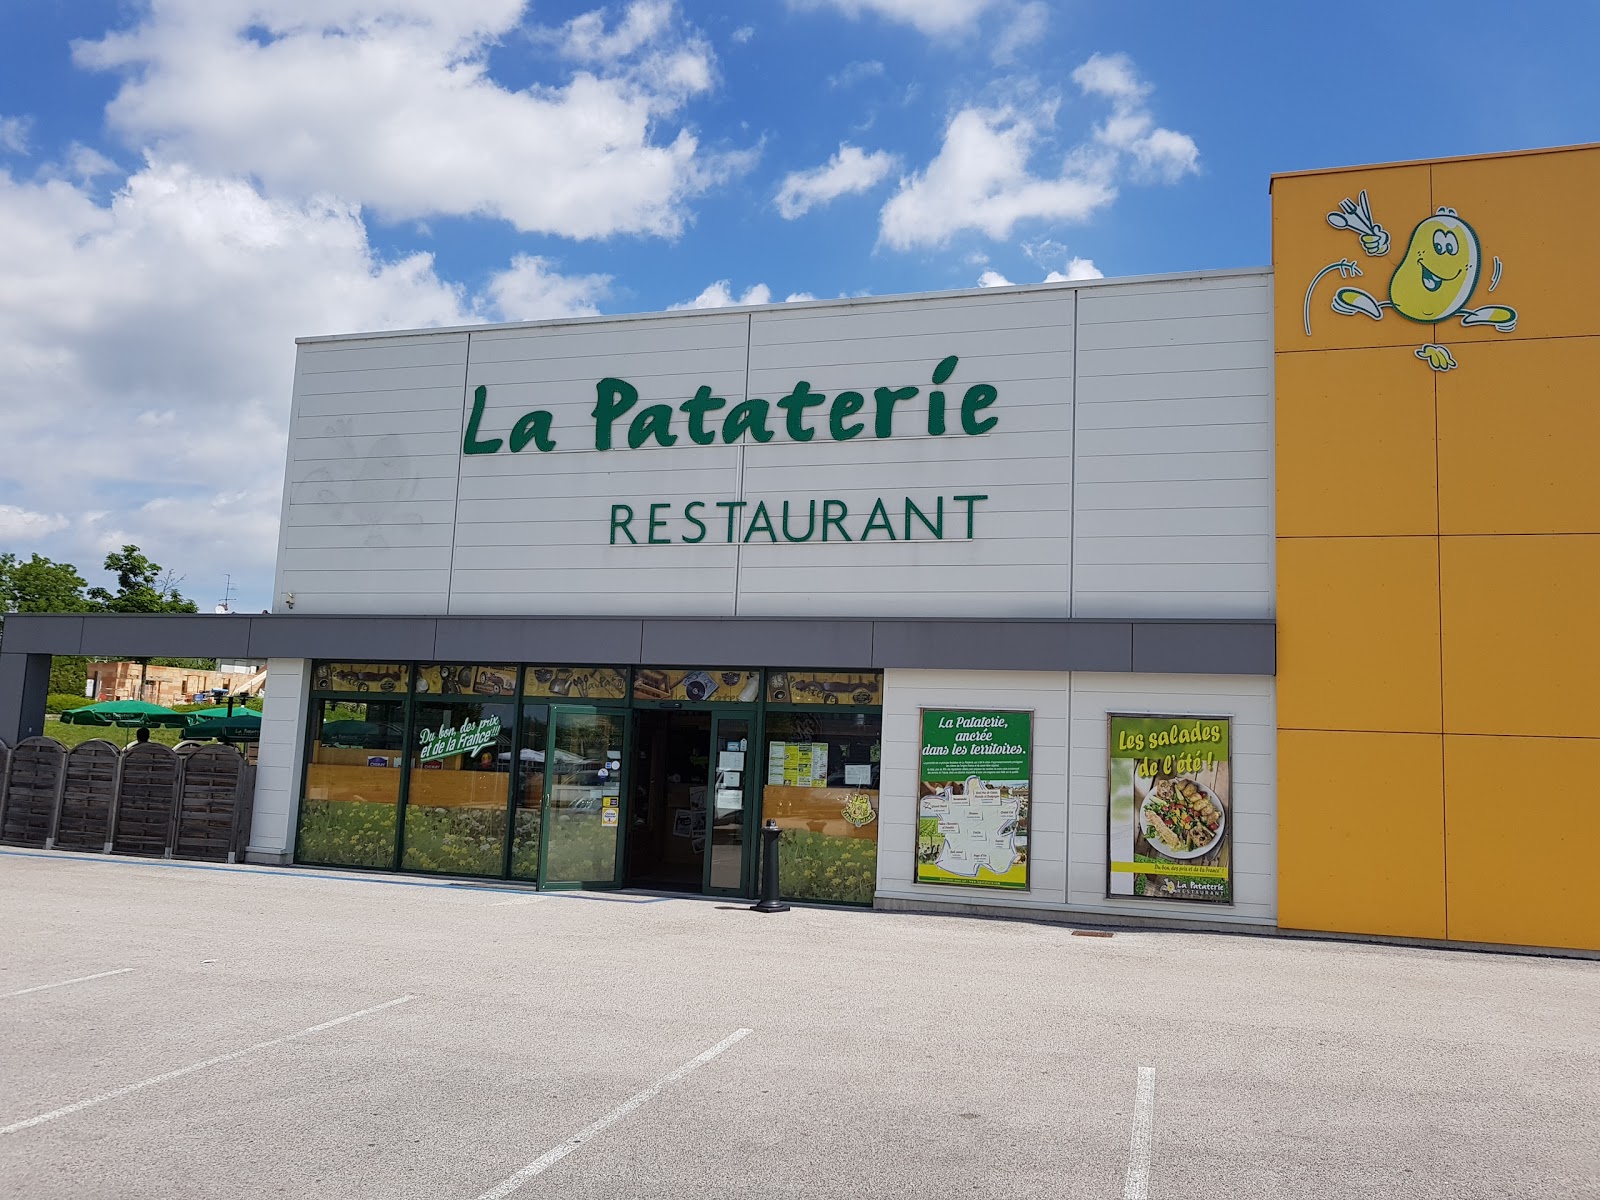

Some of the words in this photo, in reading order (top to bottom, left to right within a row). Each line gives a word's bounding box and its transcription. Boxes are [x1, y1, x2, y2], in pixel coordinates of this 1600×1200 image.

[463, 384, 556, 454] La
[591, 355, 998, 451] Pataterie
[609, 495, 988, 545] RESTAURANT
[419, 728, 436, 745] Du
[438, 723, 457, 739] bon,
[460, 717, 476, 733] des
[477, 714, 499, 733] prix
[938, 716, 953, 729] La
[956, 715, 1008, 729] Pataterie,
[955, 728, 993, 741] ancrée
[1119, 730, 1145, 751] Les
[1148, 721, 1220, 749] salades
[420, 742, 432, 758] et
[432, 740, 445, 755] de
[446, 737, 456, 752] la
[922, 743, 949, 755] dans
[951, 743, 968, 755] les
[970, 742, 1026, 755] territoires.
[1138, 756, 1159, 777] de
[1177, 881, 1187, 889] La
[1190, 881, 1224, 891] Pataterie
